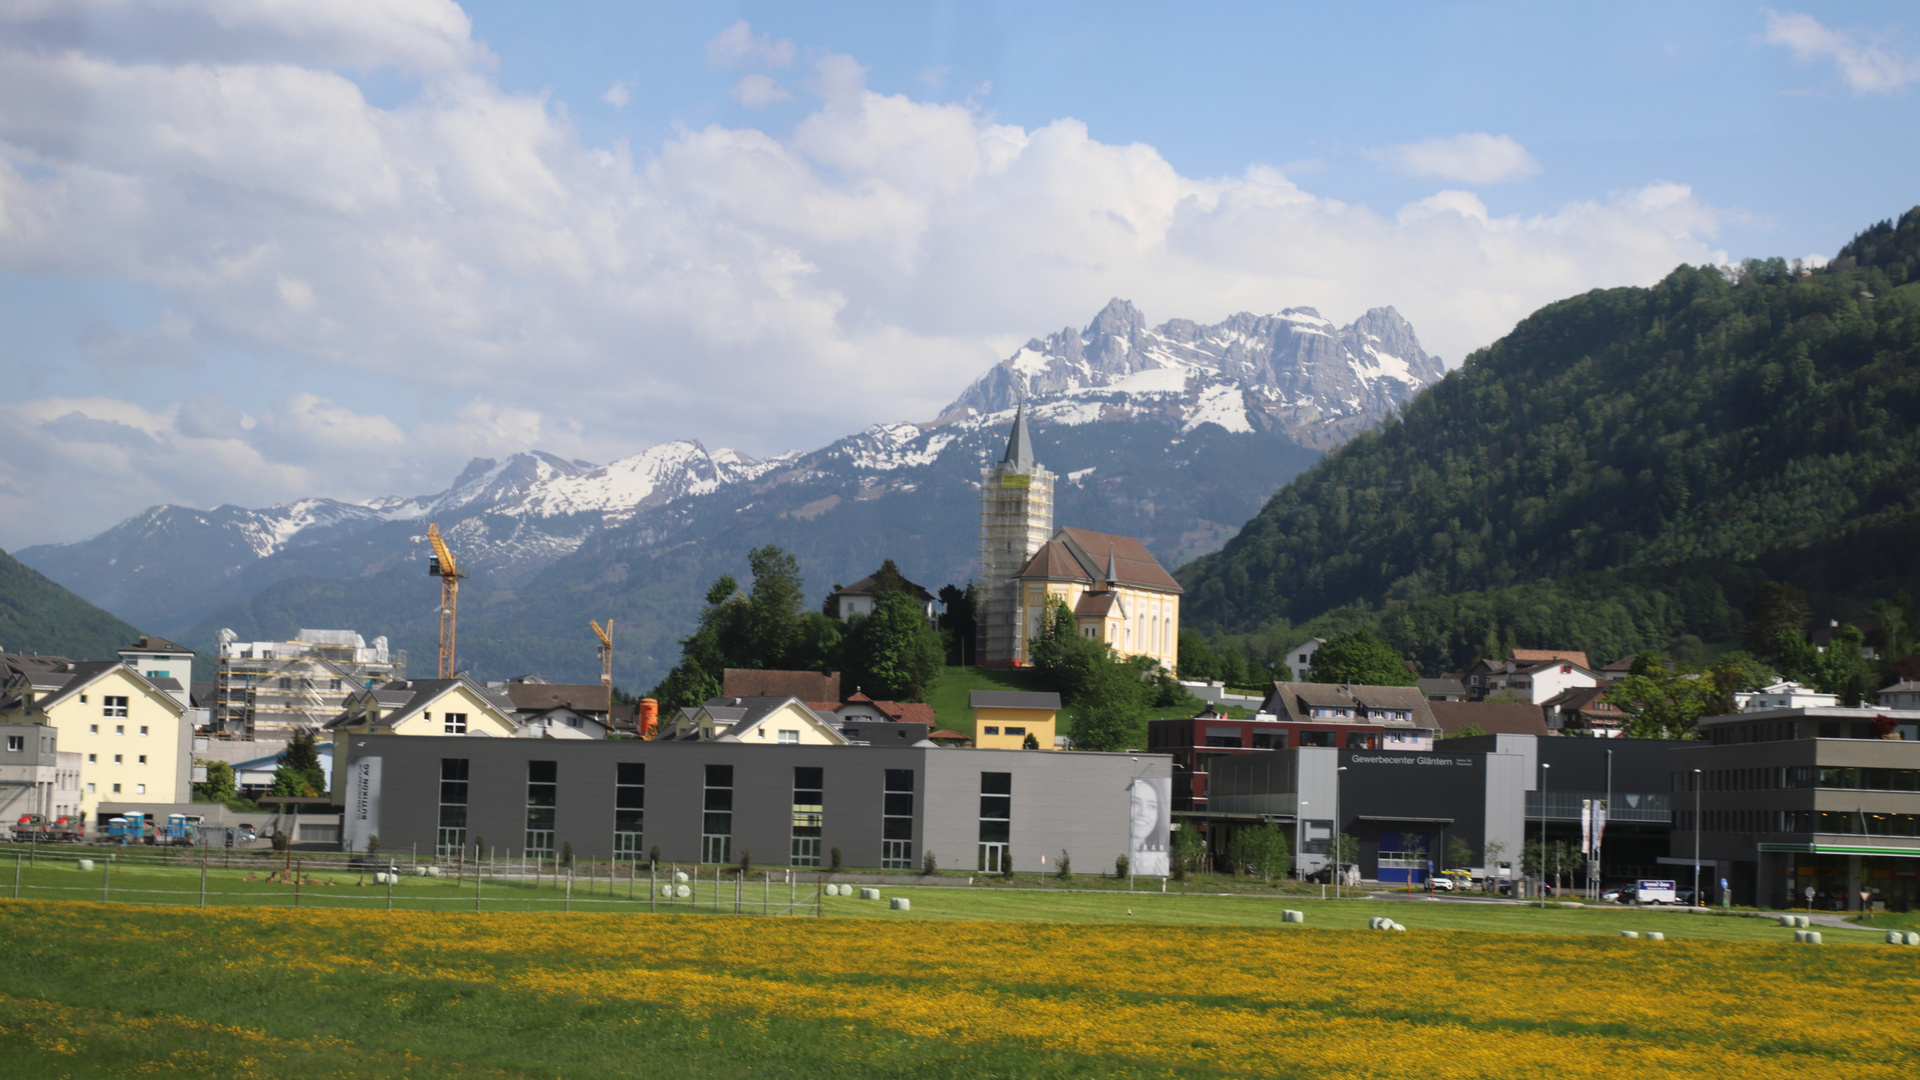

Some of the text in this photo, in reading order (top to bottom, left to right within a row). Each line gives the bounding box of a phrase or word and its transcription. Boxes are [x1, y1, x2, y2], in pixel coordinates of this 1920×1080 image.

[1351, 754, 1453, 766] Gewerbecenter Gläntern
[363, 764, 370, 776] AG
